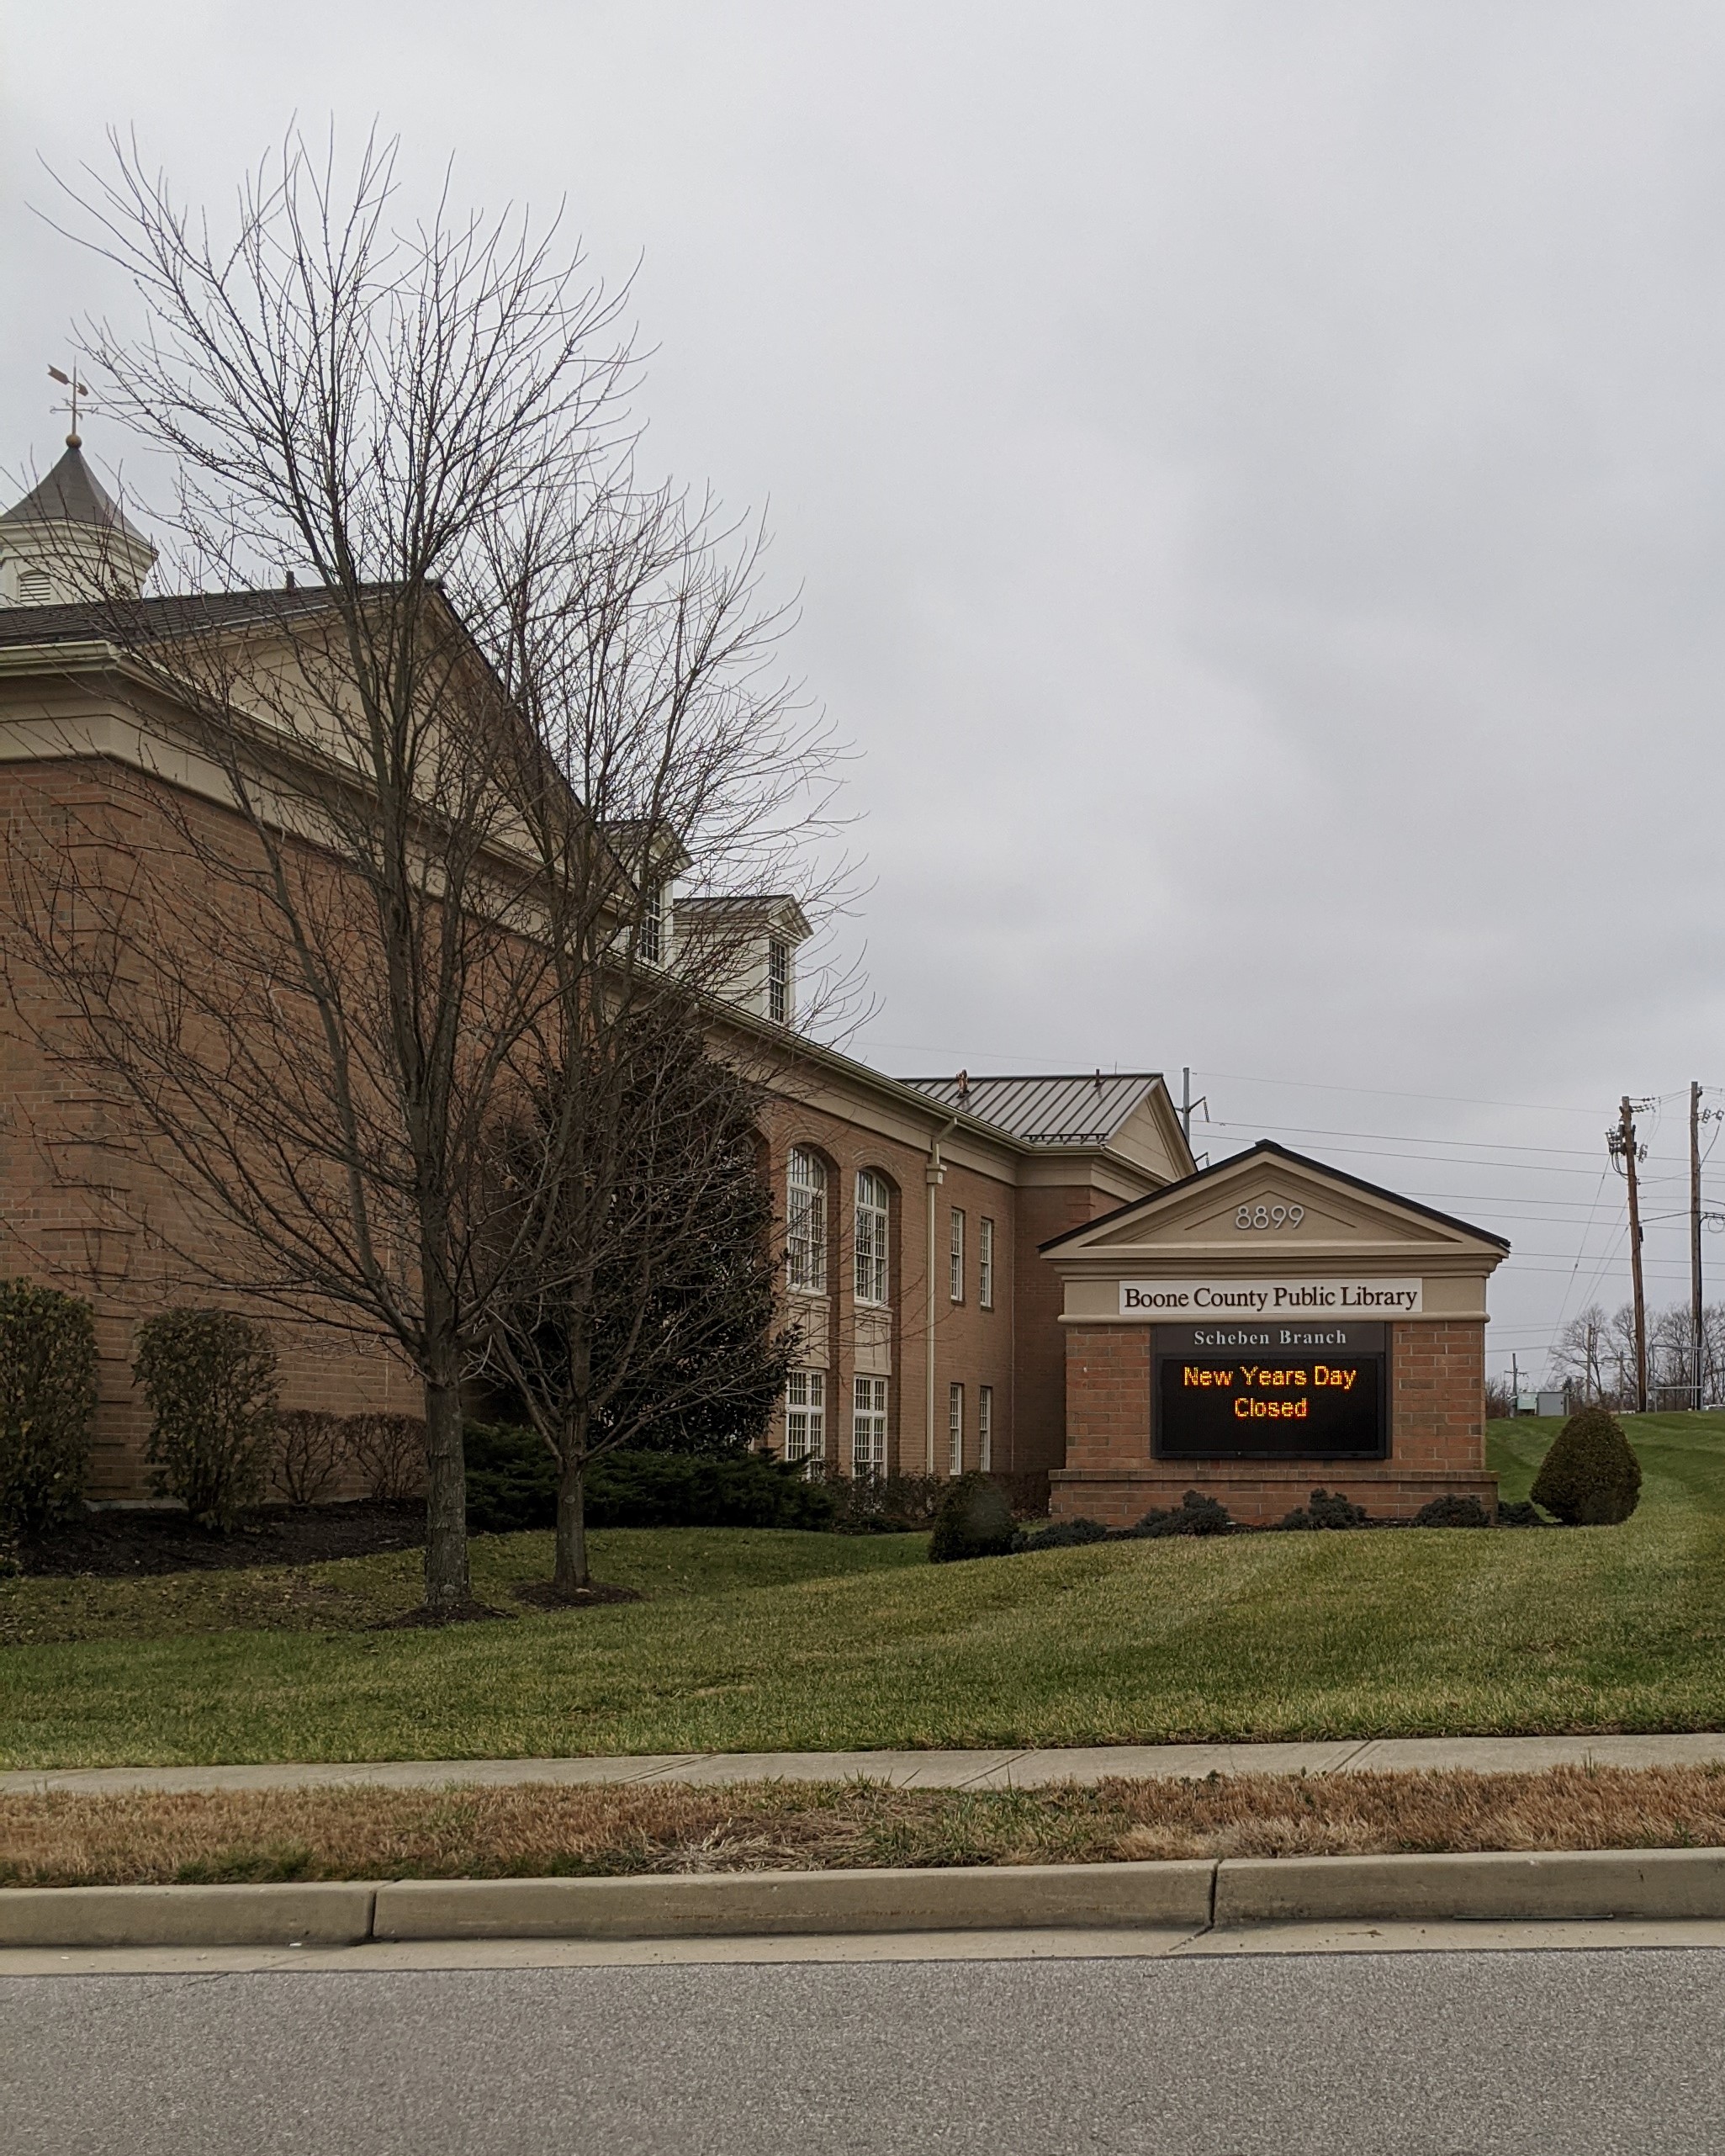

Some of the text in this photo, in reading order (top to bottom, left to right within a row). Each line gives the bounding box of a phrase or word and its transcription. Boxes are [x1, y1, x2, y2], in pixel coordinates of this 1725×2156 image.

[1235, 1205, 1305, 1230] 8899
[1124, 1286, 1418, 1311] Boone County Public Library
[1193, 1330, 1347, 1345] Scheben Branch
[1183, 1365, 1357, 1390] New Years Day
[1234, 1397, 1308, 1417] Closed
